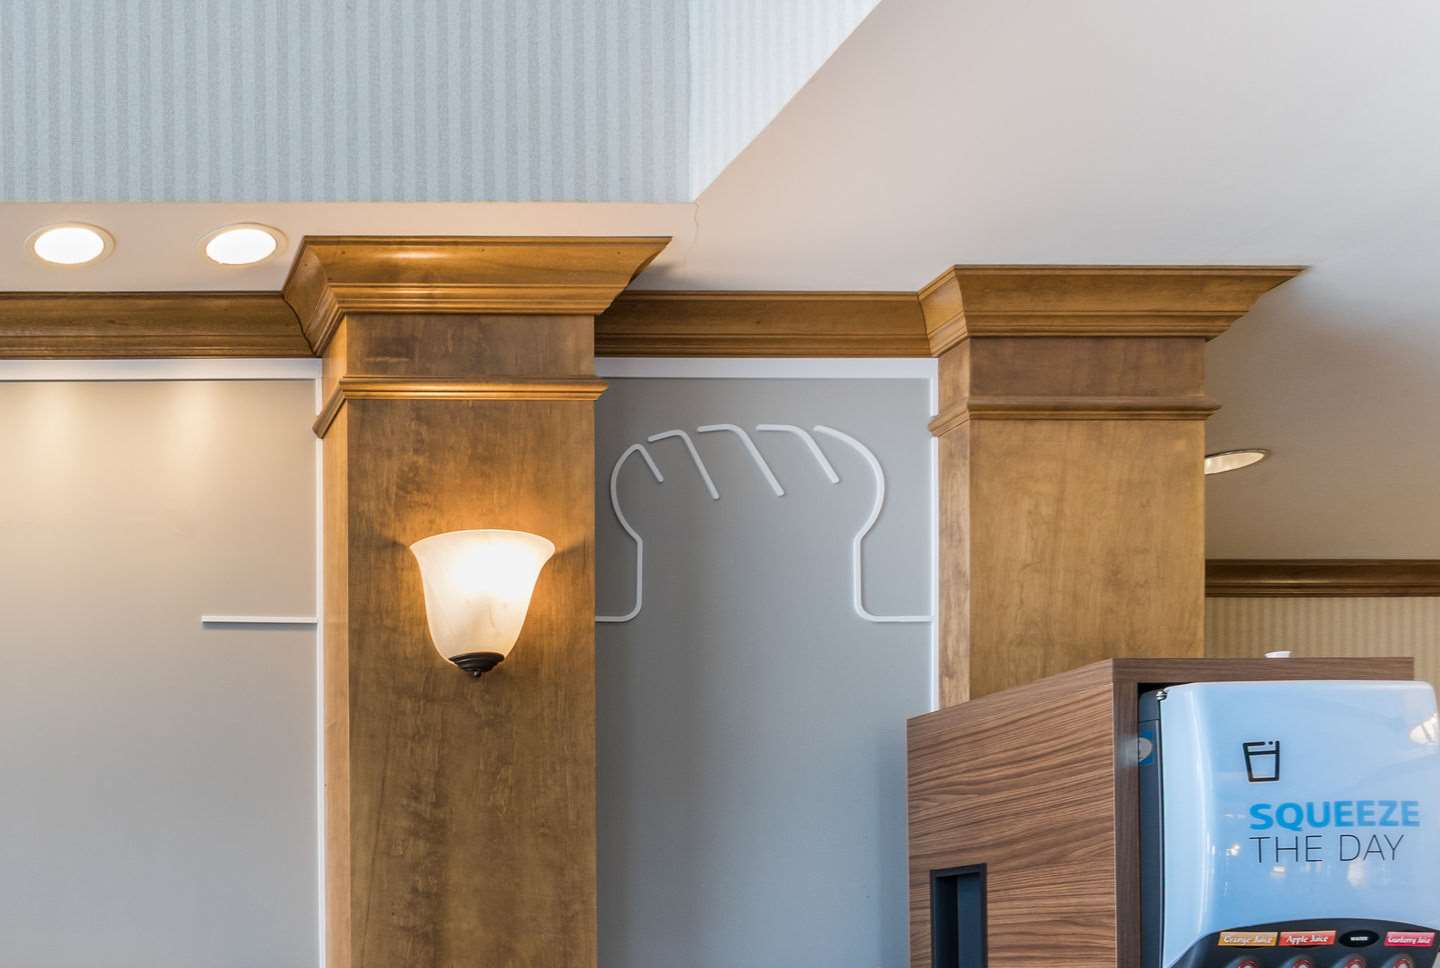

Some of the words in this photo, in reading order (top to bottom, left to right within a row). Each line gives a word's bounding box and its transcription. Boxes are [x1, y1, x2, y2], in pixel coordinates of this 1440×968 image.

[1249, 801, 1420, 831] SQUEEZE
[1249, 834, 1323, 863] THE
[1340, 834, 1404, 862] DAY
